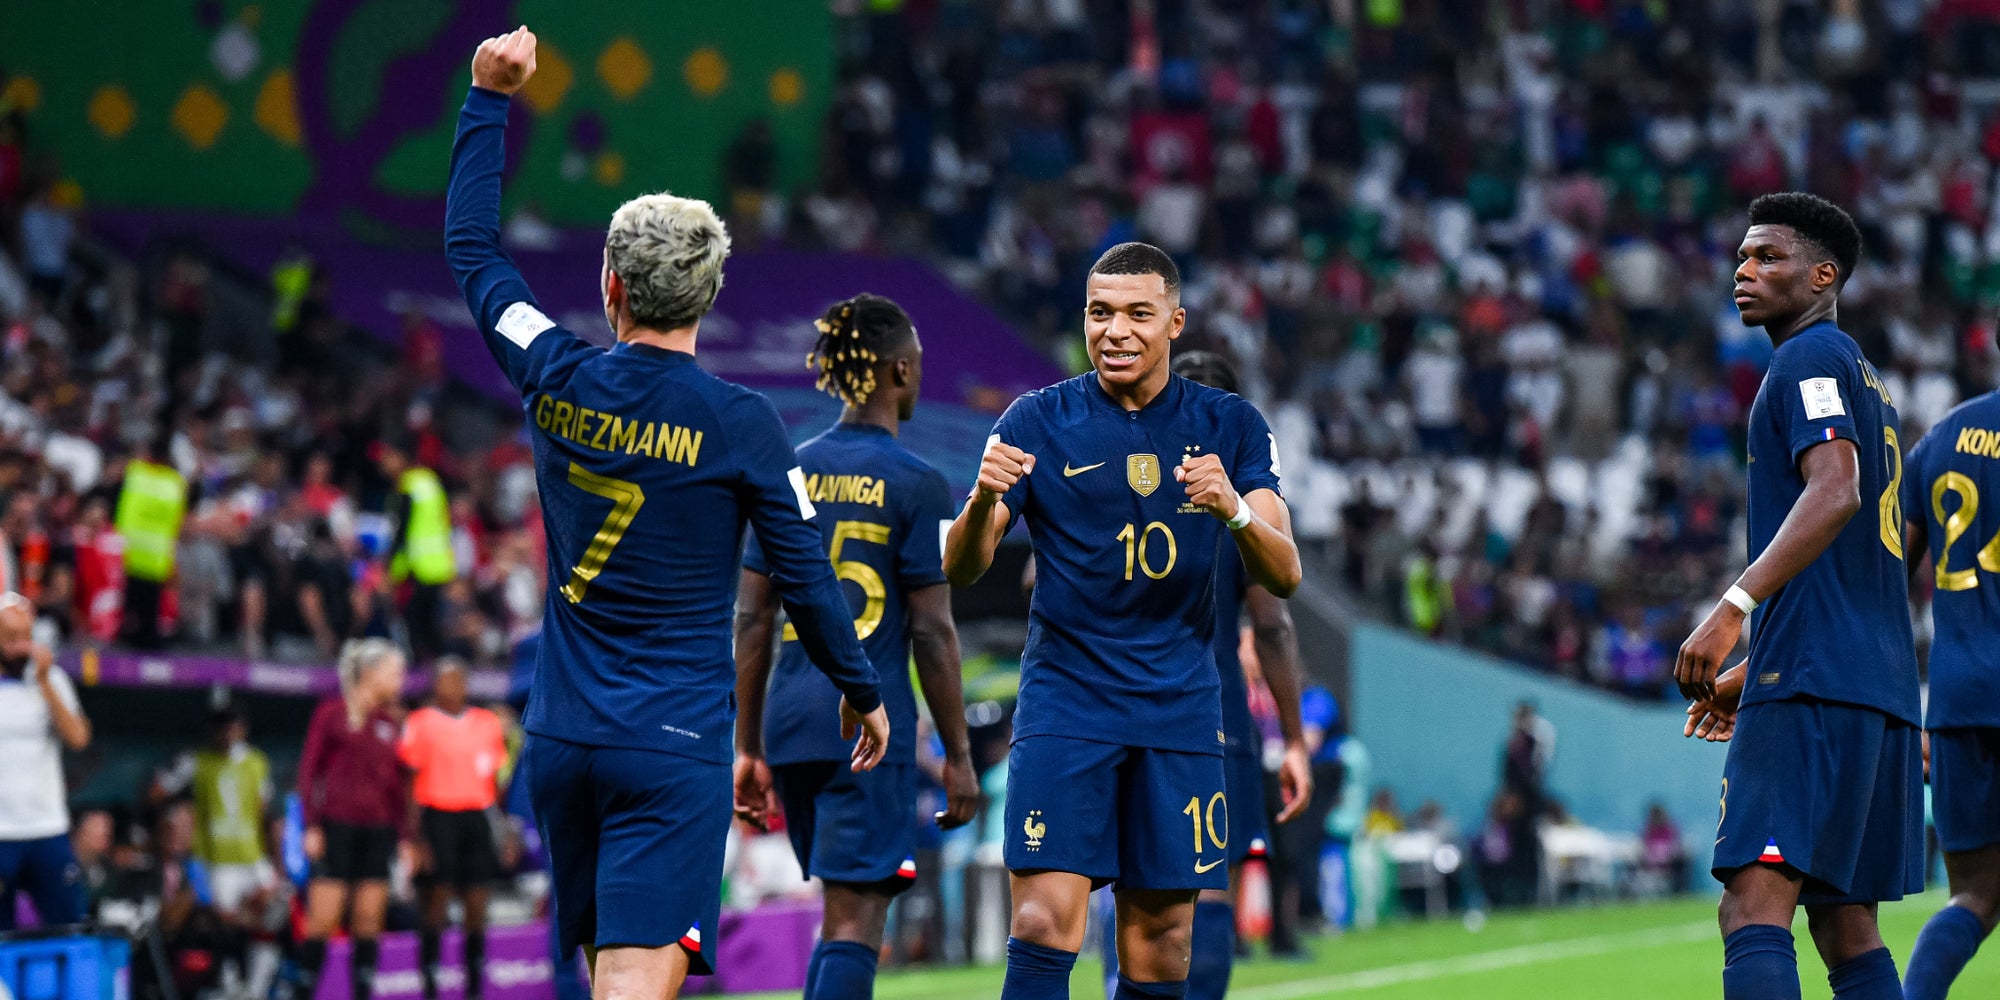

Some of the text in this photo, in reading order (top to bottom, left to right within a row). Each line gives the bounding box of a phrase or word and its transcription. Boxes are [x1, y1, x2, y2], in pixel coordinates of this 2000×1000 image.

[536, 393, 704, 467] GRIEZMANN
[802, 473, 886, 508] MAVINGA
[559, 460, 646, 604] 7
[1116, 521, 1177, 581] 10
[1183, 791, 1228, 854] 10
